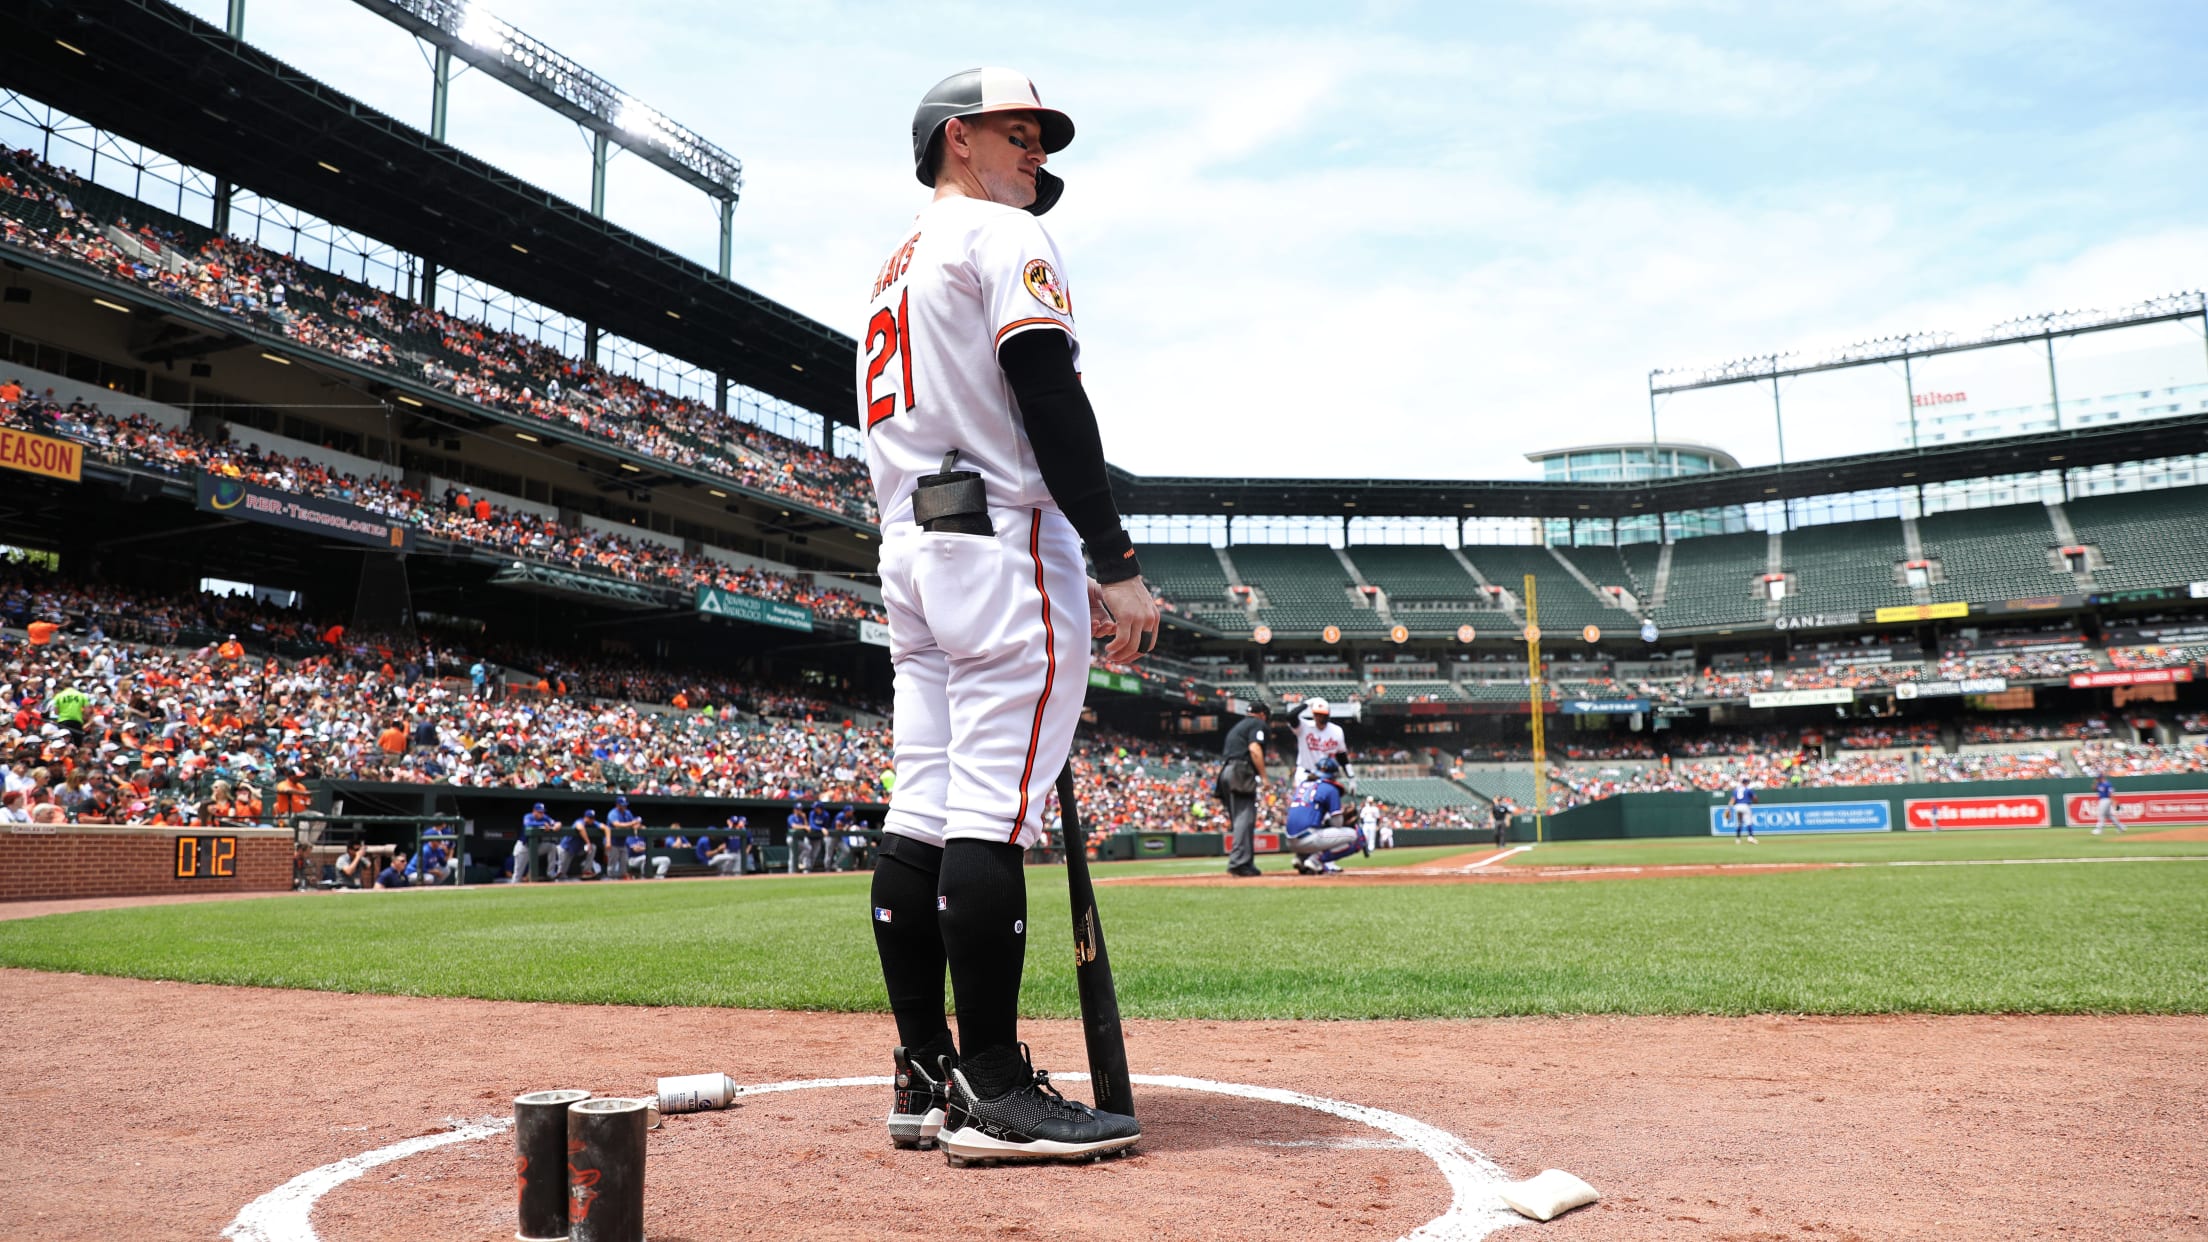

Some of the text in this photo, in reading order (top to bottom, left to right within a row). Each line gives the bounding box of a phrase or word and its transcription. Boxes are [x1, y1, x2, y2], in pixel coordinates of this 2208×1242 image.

[865, 285, 915, 437] 21
[1775, 614, 1825, 630] GANZ
[1960, 803, 2039, 819] markets
